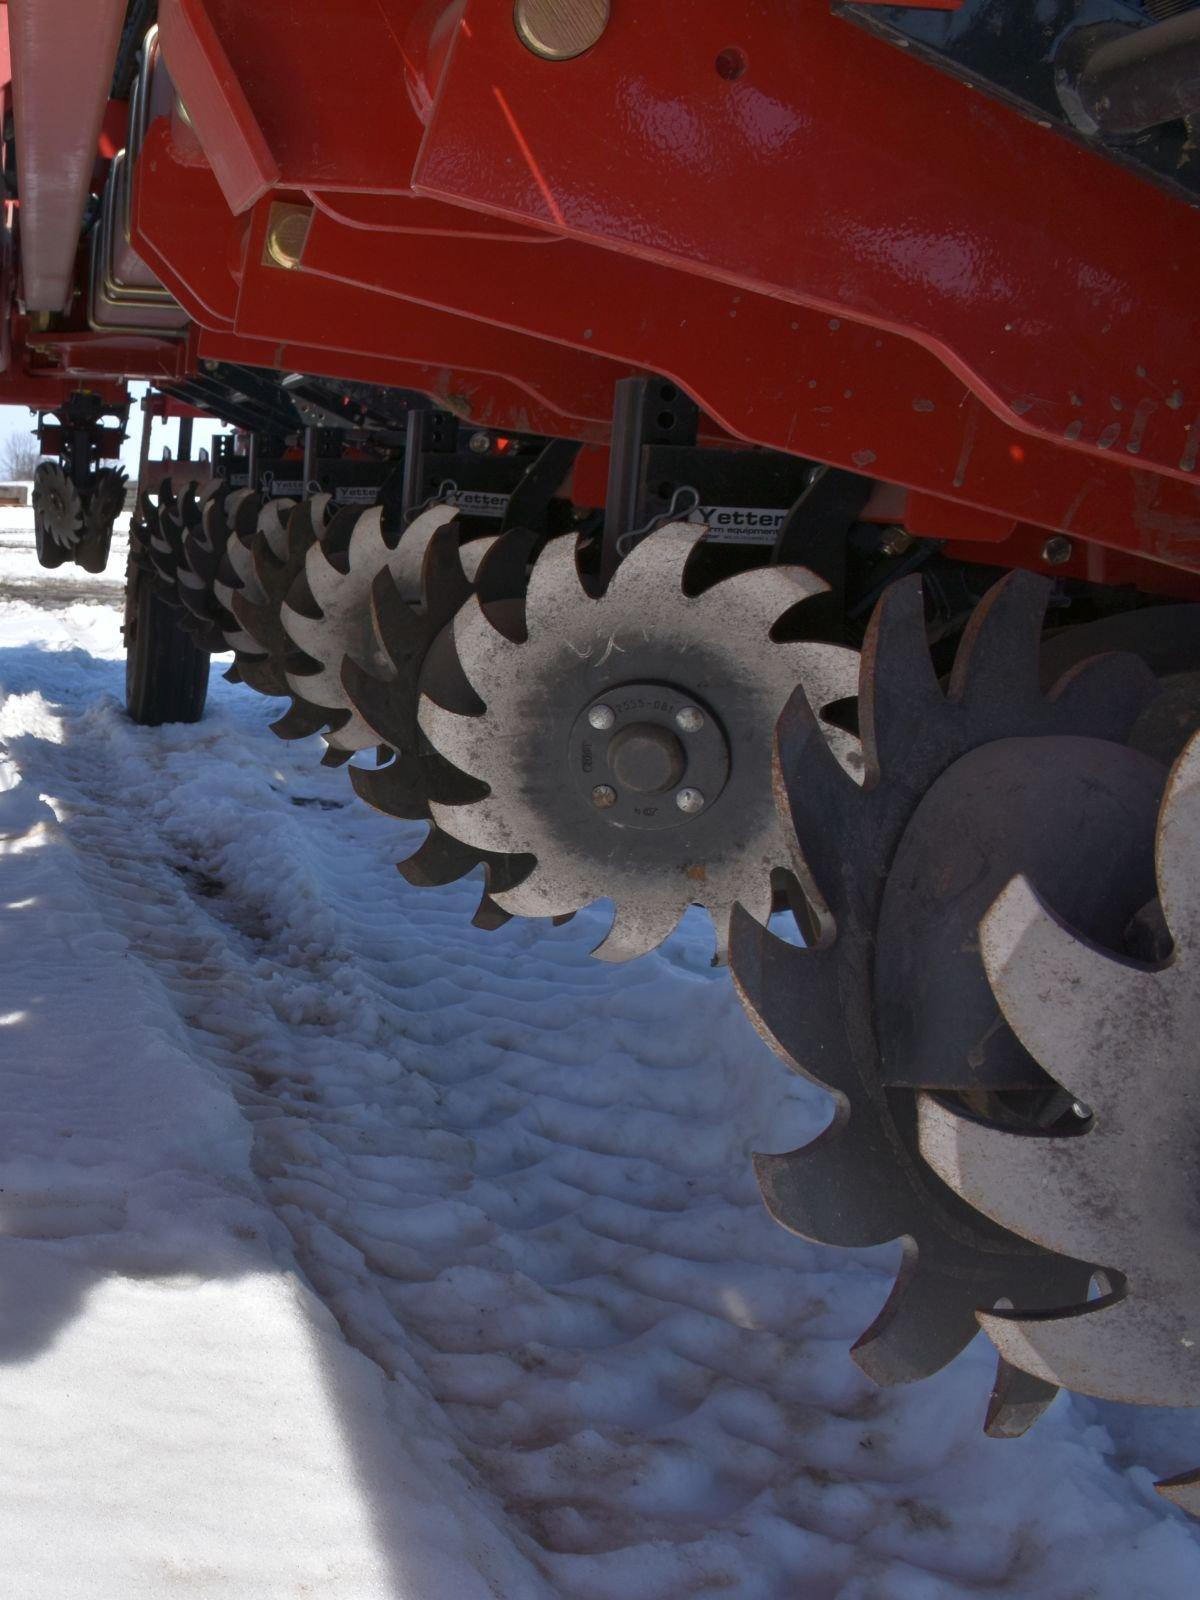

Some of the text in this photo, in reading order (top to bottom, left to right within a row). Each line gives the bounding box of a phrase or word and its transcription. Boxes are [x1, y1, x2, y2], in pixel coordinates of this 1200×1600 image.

[340, 487, 376, 496] Yette
[454, 491, 508, 505] Yetter
[698, 508, 784, 527] Yetter
[727, 527, 779, 536] equipment
